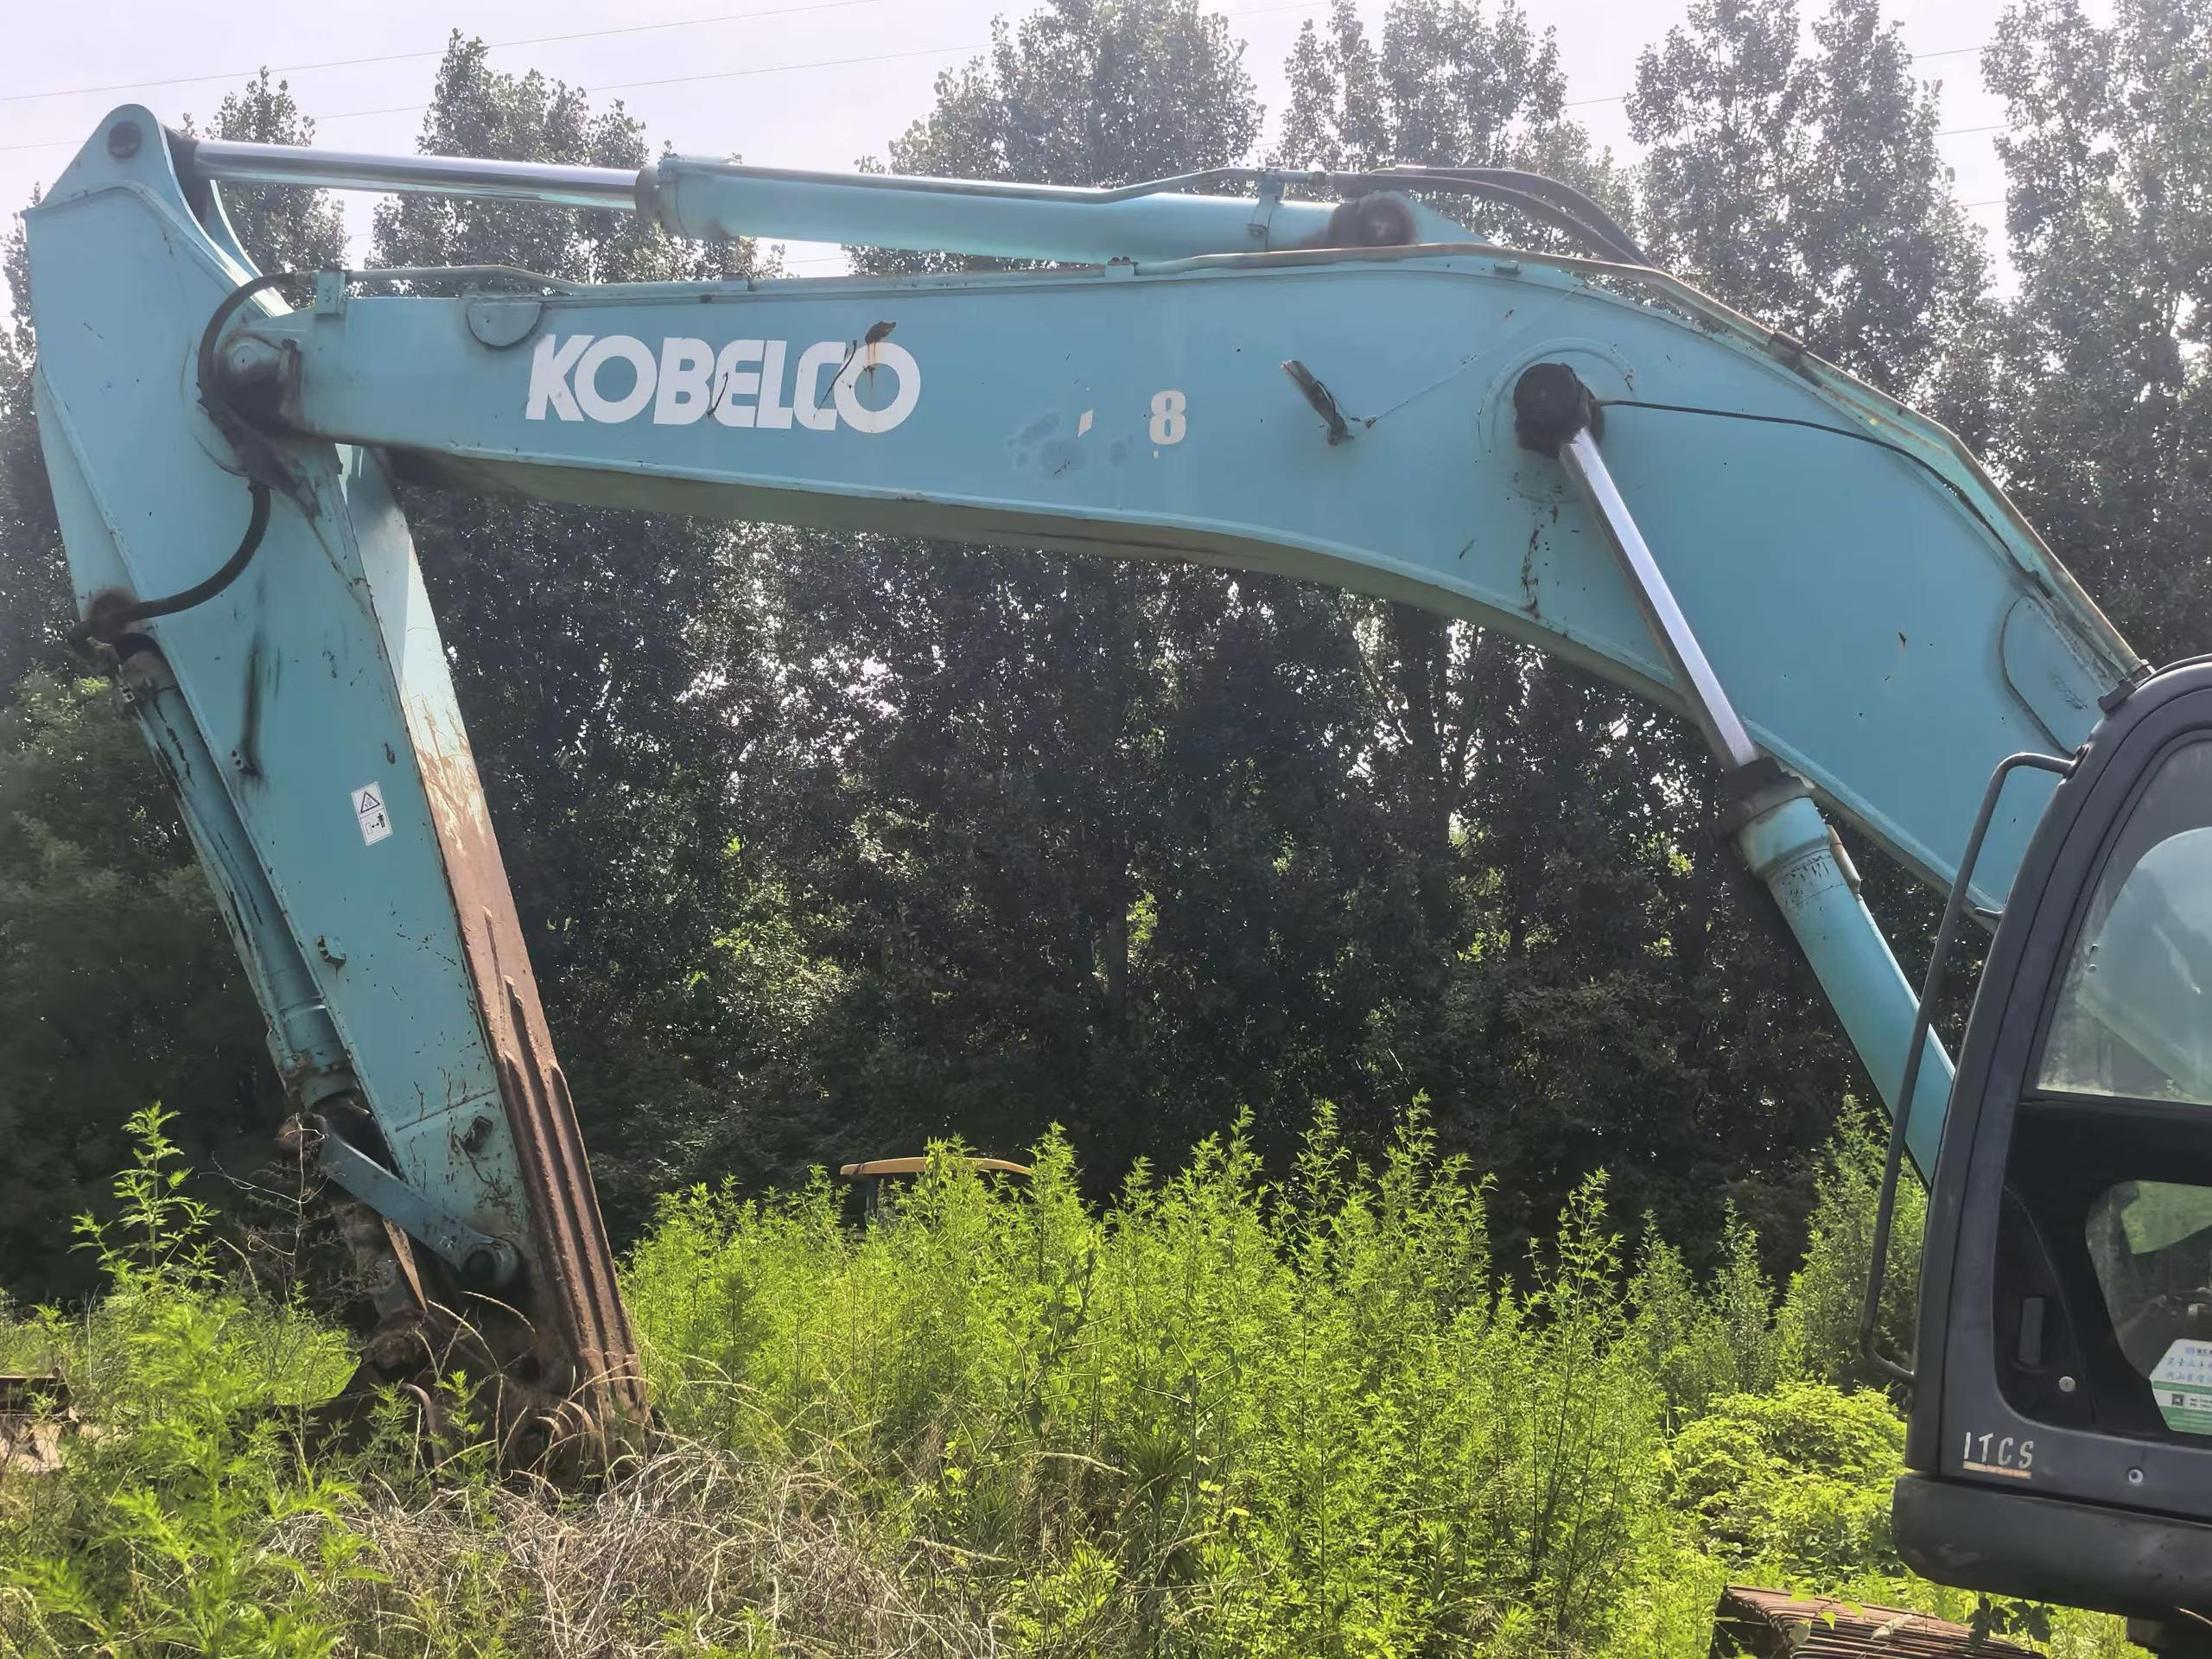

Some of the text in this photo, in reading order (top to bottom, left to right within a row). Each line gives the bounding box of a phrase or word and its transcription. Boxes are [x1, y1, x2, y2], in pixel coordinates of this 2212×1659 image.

[525, 334, 921, 434] KOBELCO
[1149, 390, 1186, 445] 8
[1963, 1431, 2034, 1469] ITCS
